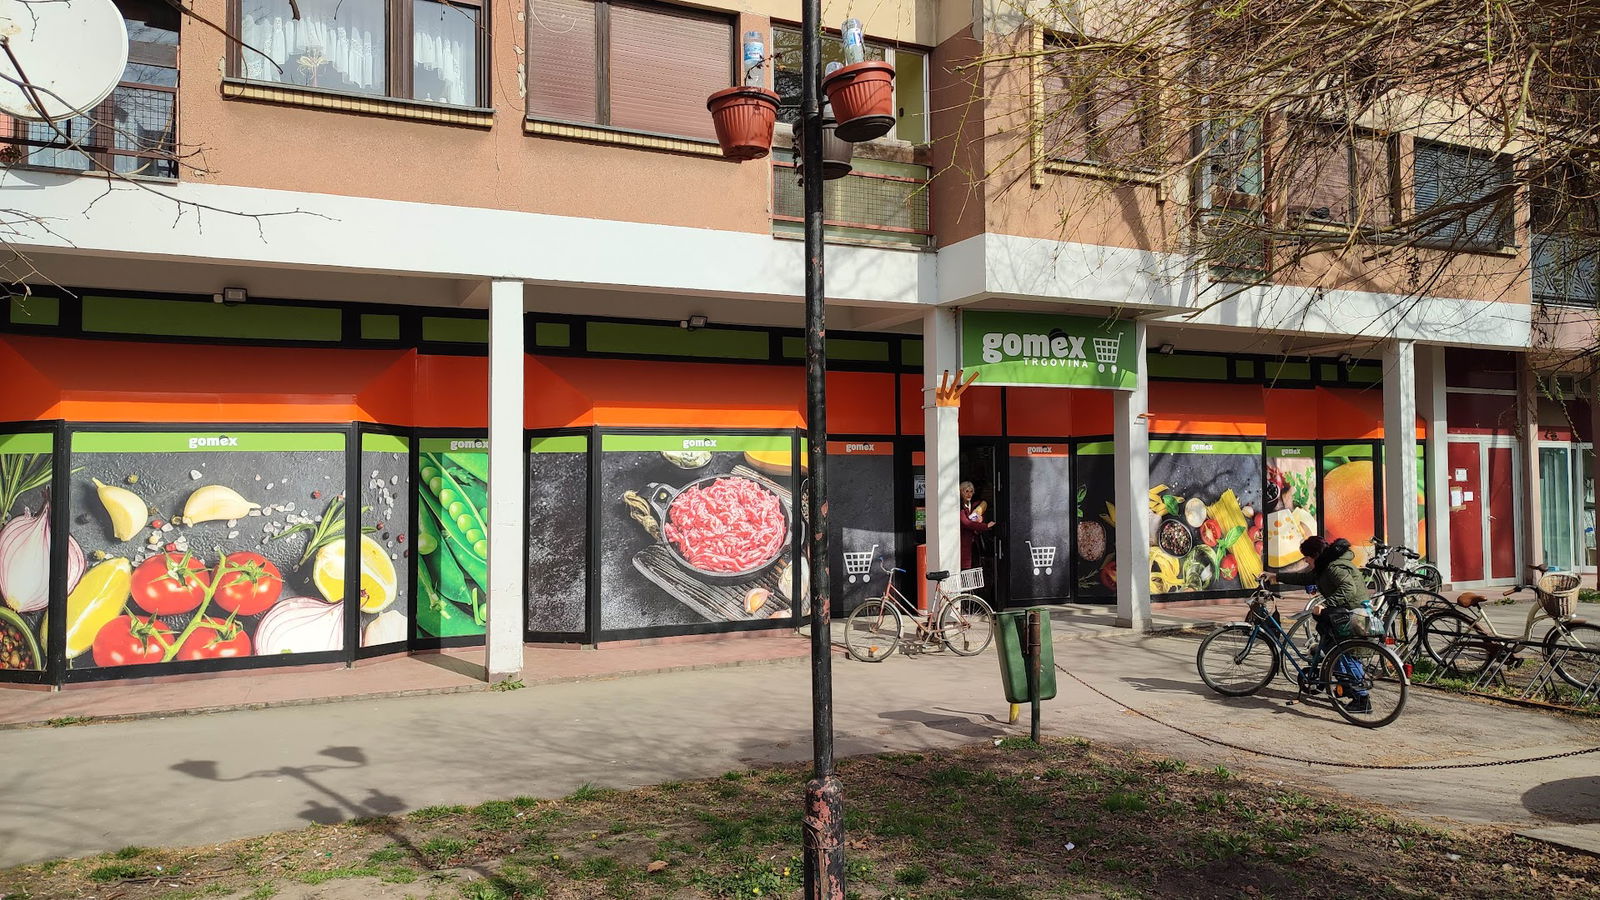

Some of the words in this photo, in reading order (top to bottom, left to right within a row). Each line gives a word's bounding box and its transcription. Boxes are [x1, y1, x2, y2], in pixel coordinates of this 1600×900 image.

[982, 332, 1087, 364] gomex
[1023, 357, 1089, 368] TRGOVINA
[188, 437, 238, 449] gomex
[450, 440, 489, 451] gomex
[682, 439, 717, 449] gomex
[845, 443, 875, 453] gomex
[1027, 446, 1053, 454] gomex
